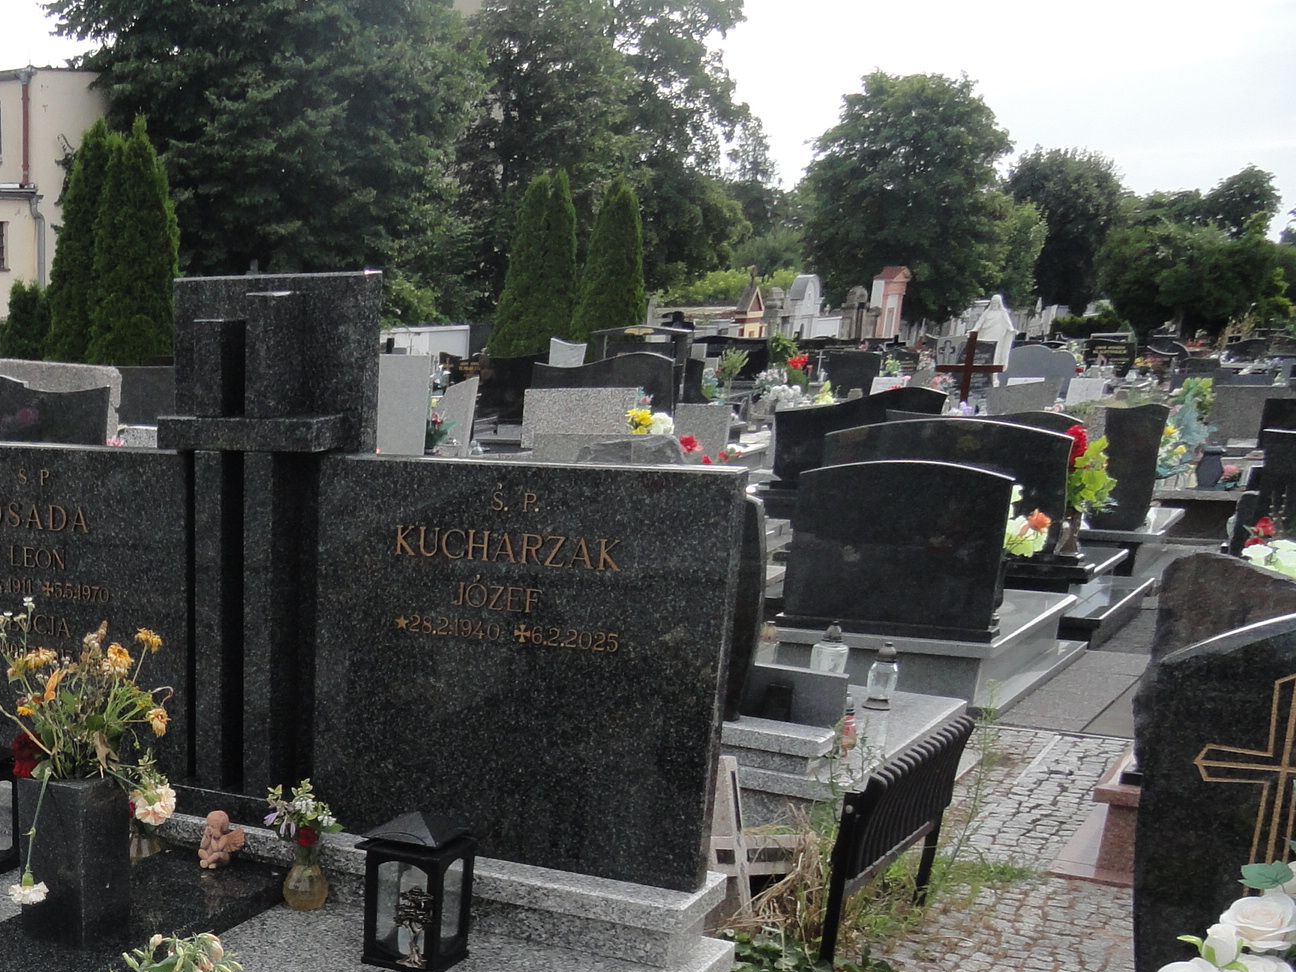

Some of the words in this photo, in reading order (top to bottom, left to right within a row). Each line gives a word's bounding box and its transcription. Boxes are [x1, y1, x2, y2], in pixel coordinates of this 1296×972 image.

[10, 545, 65, 569] LEON
[394, 524, 621, 572] KUCHARZAK
[454, 574, 543, 613] JÓZEF
[409, 614, 500, 640] 28.2.1940
[530, 625, 619, 652] 6.2.2025
